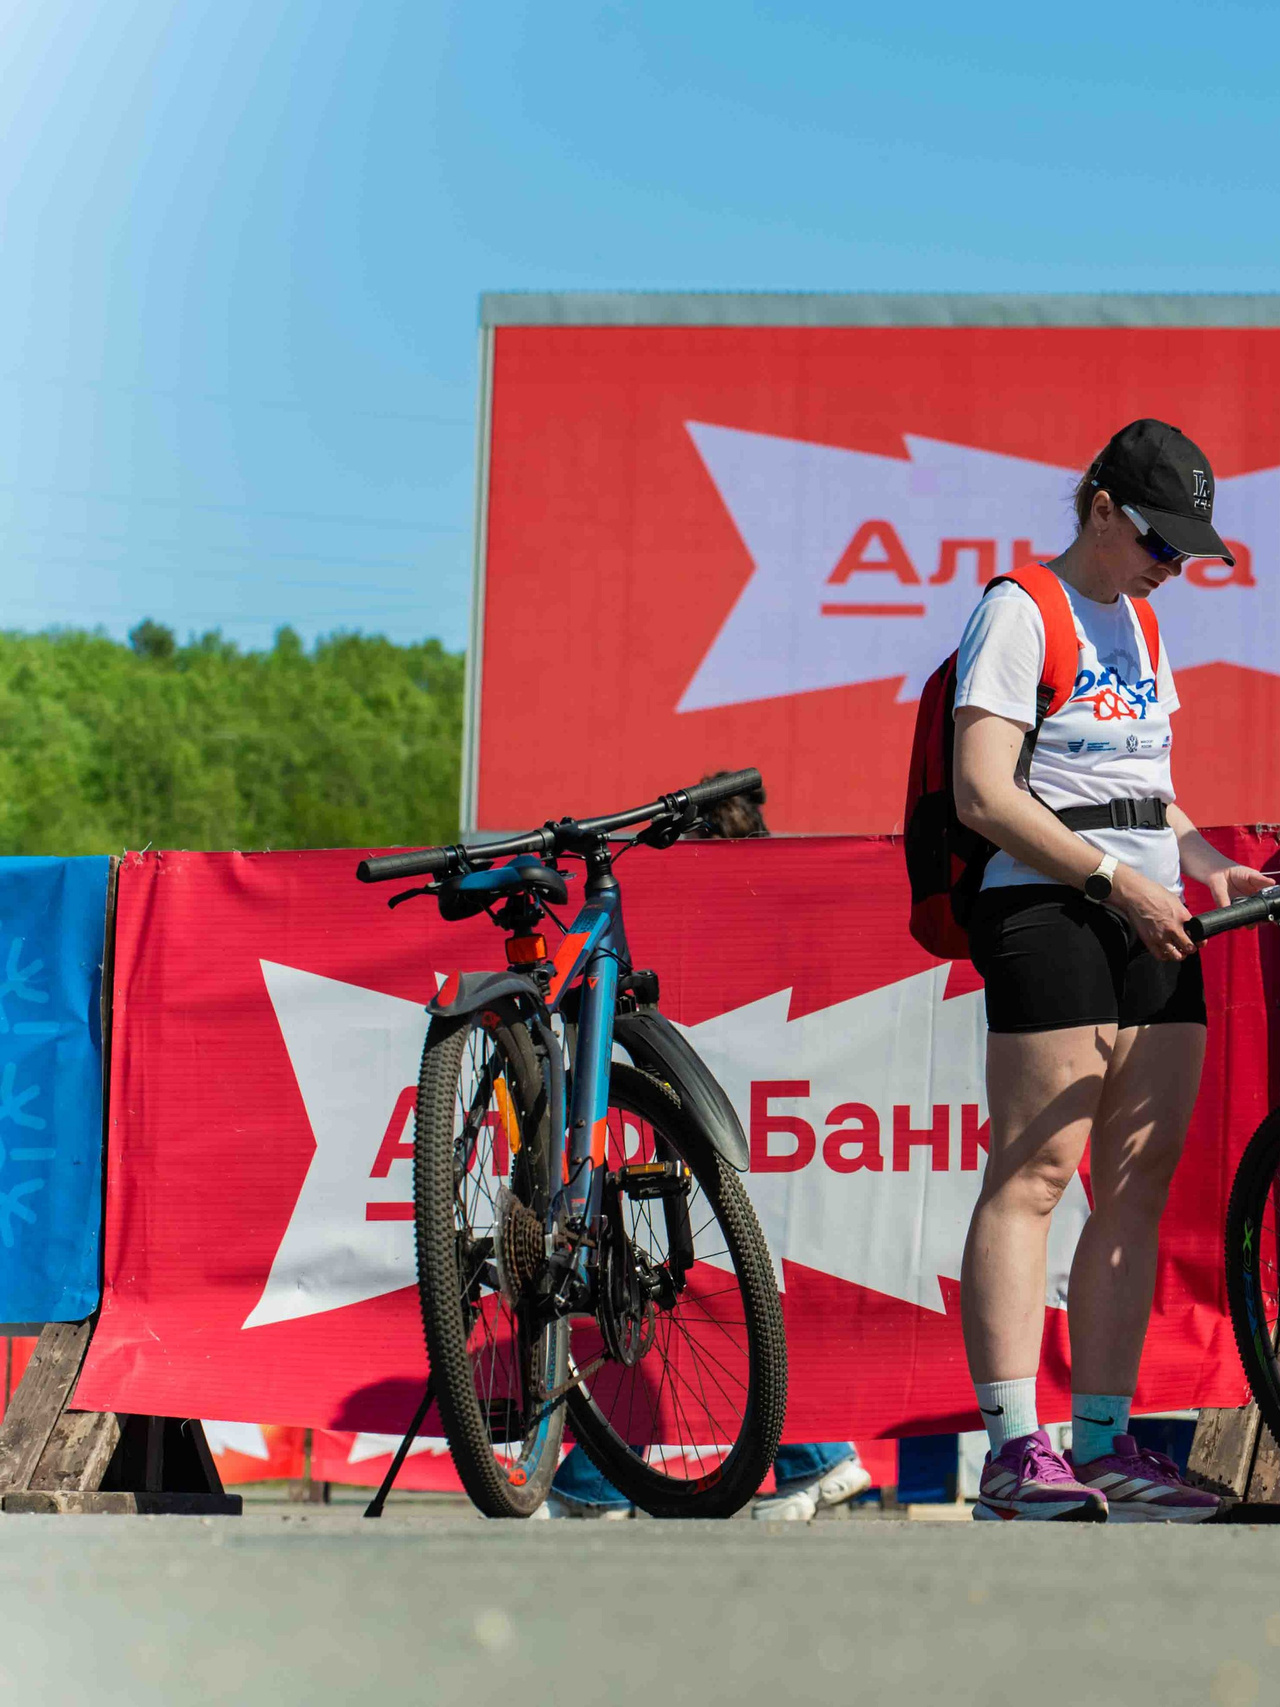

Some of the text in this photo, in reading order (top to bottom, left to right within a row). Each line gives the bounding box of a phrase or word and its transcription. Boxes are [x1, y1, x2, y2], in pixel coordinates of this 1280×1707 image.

[1193, 469, 1211, 510] LA
[826, 519, 1256, 587] Альа
[749, 1079, 992, 1173] Банк
